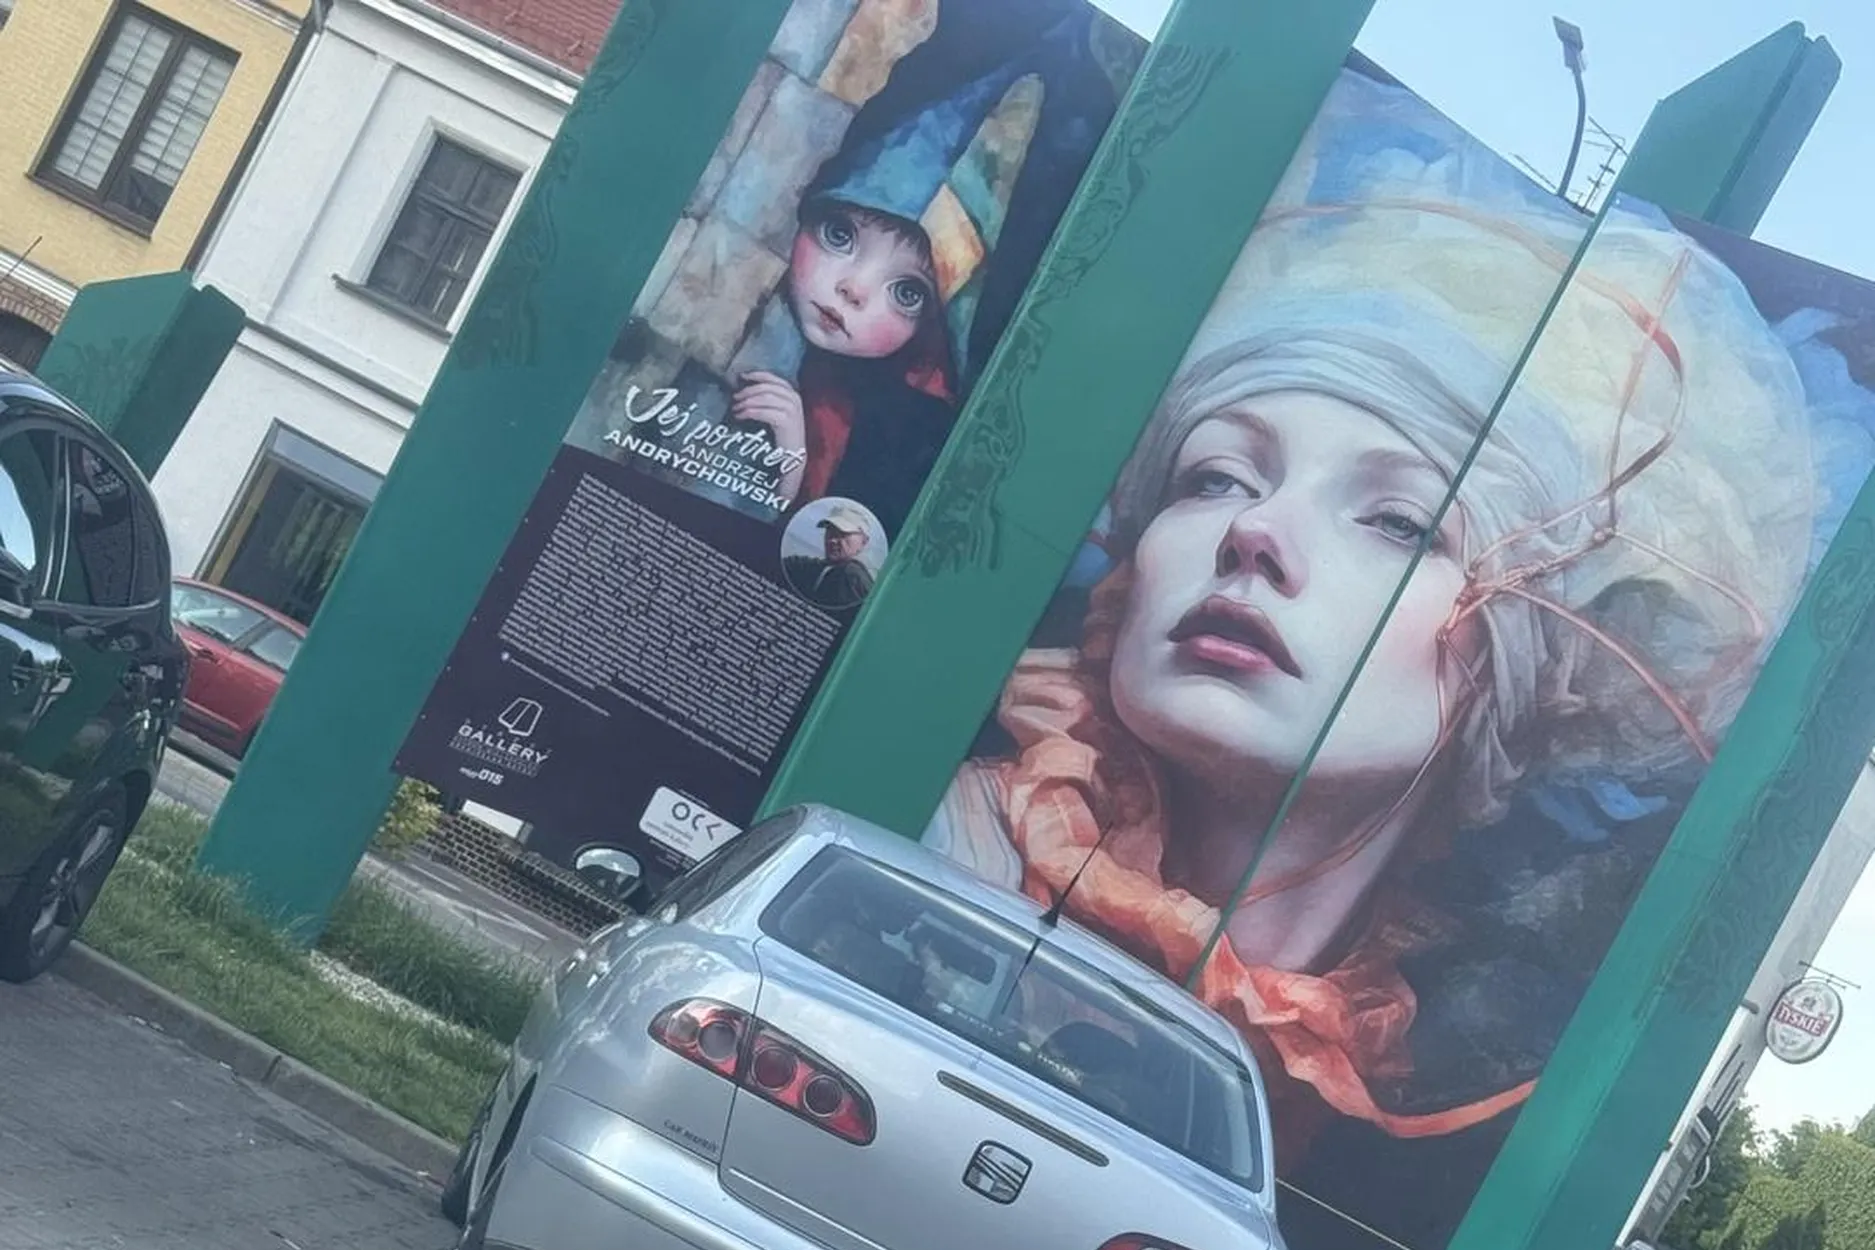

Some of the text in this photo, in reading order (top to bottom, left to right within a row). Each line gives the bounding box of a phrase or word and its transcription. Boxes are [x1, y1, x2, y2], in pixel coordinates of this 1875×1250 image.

[625, 385, 806, 475] Jej portret
[603, 429, 790, 512] ANDRYCHOWSKI
[681, 444, 780, 490] ANDRZEJ
[458, 724, 549, 764] GALLERY
